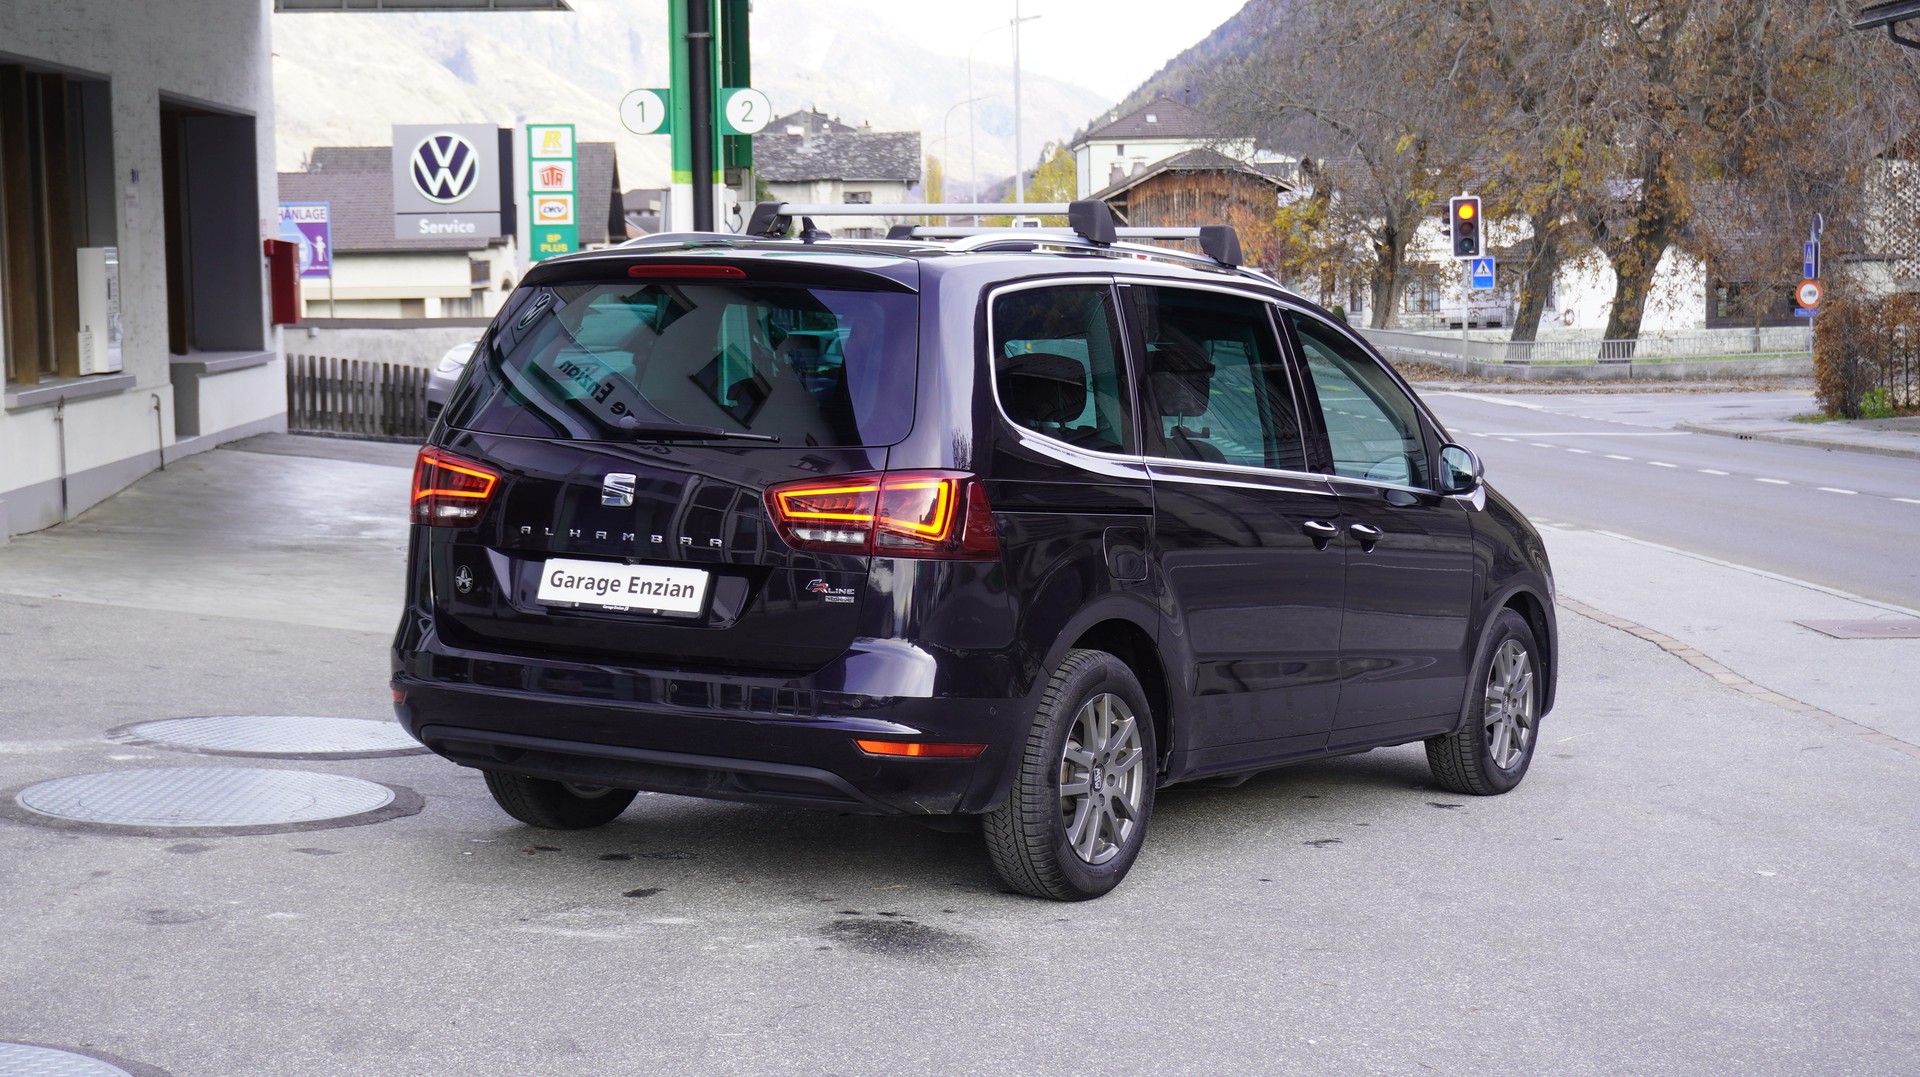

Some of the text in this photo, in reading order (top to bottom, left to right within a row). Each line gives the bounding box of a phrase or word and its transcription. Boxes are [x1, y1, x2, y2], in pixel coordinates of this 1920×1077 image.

[636, 101, 645, 123] 1
[740, 100, 754, 122] 2
[541, 166, 565, 186] UTA
[418, 219, 476, 234] Service
[540, 243, 569, 252] PLUS
[546, 233, 562, 243] BP
[520, 525, 723, 547] ALHAMBRA
[550, 570, 695, 598] Garage Enzian
